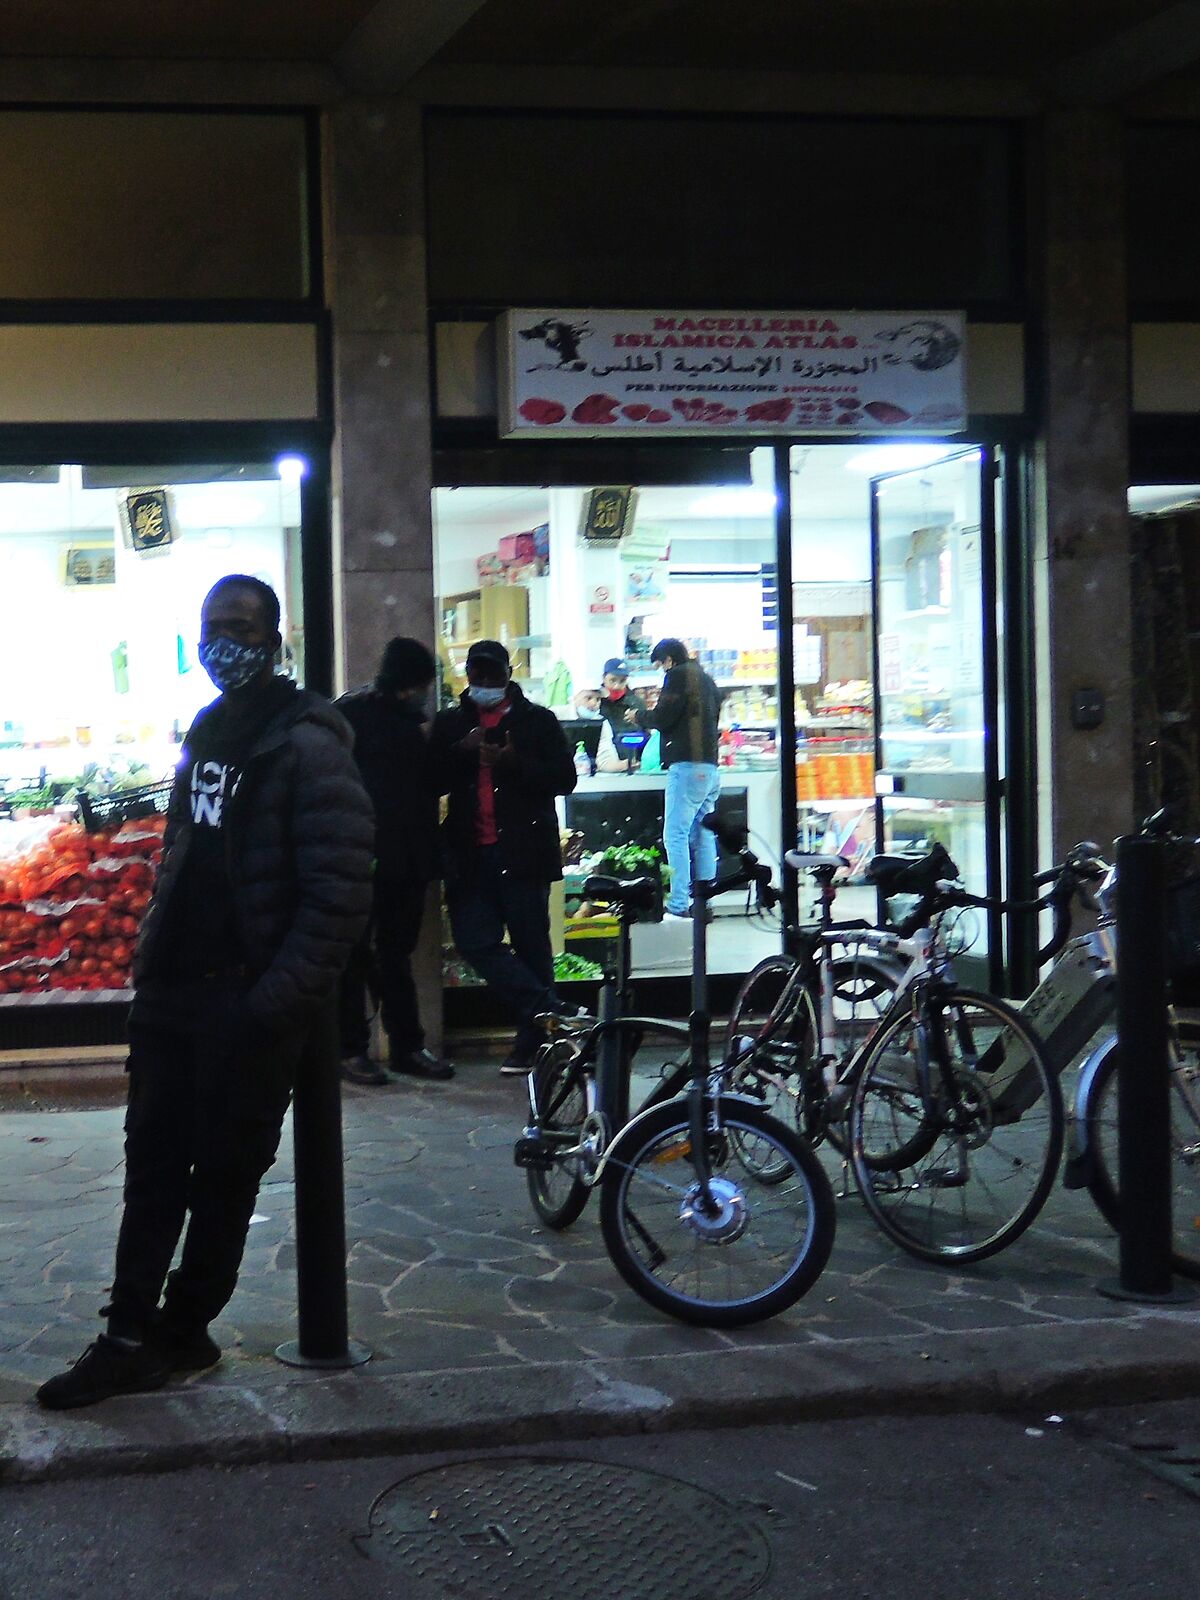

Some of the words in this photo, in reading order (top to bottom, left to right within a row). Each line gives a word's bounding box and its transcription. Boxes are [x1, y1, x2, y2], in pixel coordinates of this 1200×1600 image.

[653, 317, 840, 332] MACELLERIA
[613, 334, 756, 348] ISLAMICA
[764, 334, 859, 349] ATLAS
[591, 352, 662, 377] أطلس
